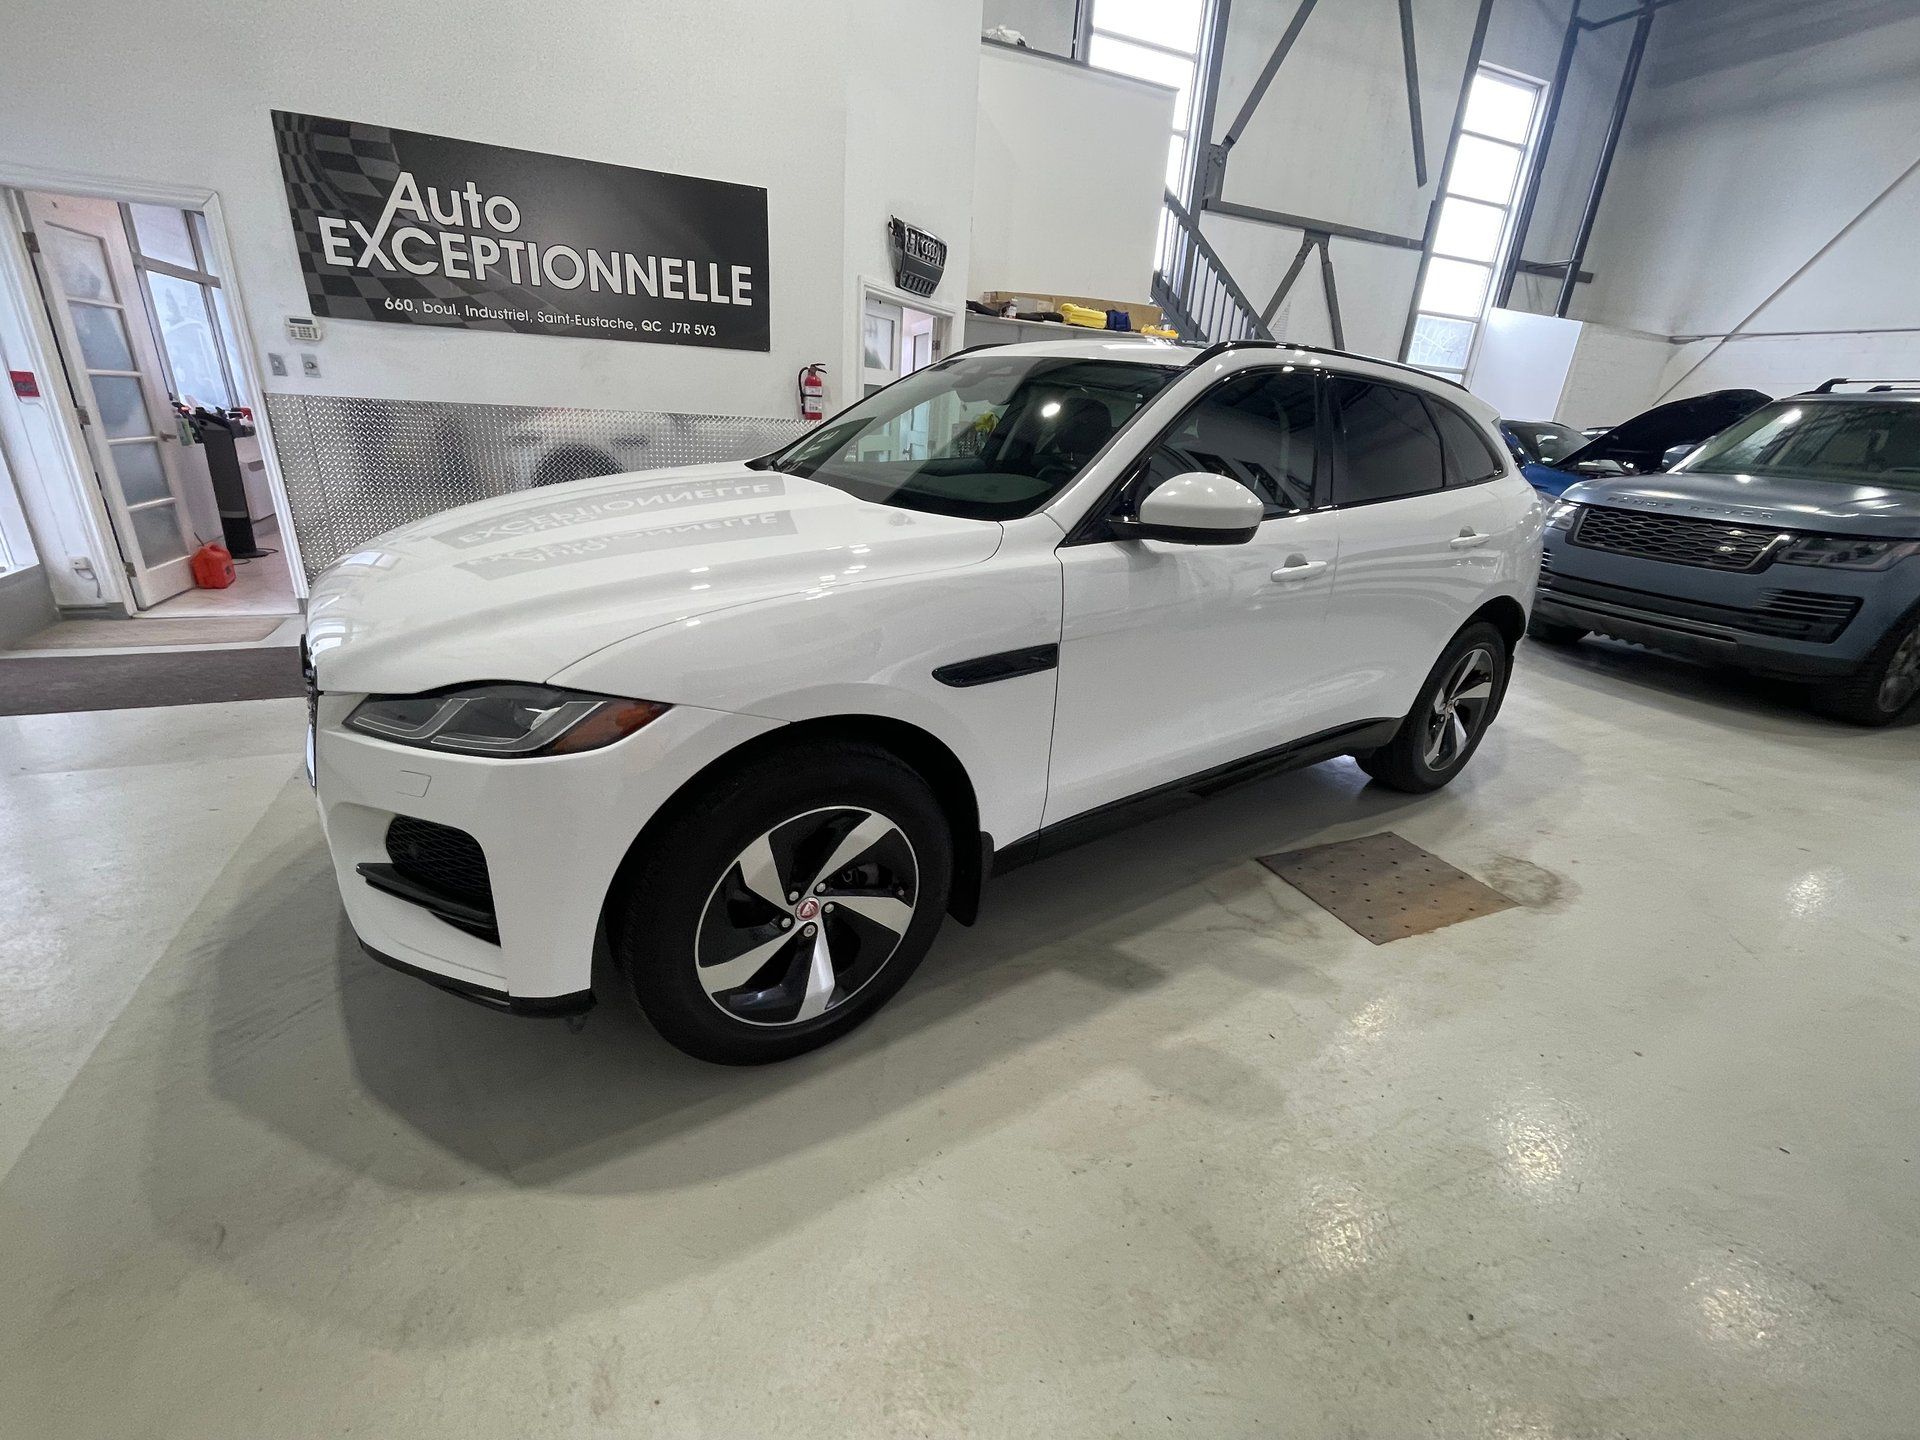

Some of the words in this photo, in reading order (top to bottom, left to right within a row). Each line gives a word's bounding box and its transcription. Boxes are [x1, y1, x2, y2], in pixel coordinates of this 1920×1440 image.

[373, 171, 521, 233] Auto
[317, 215, 753, 307] EXCEPTIONNELLE
[384, 297, 419, 314] 660,
[422, 301, 461, 316] boul.
[465, 304, 533, 324] Industriel,
[537, 311, 638, 332] Saint-Eustache,
[641, 319, 662, 332] QC
[669, 322, 691, 335] J7R
[694, 326, 717, 337] 5V3
